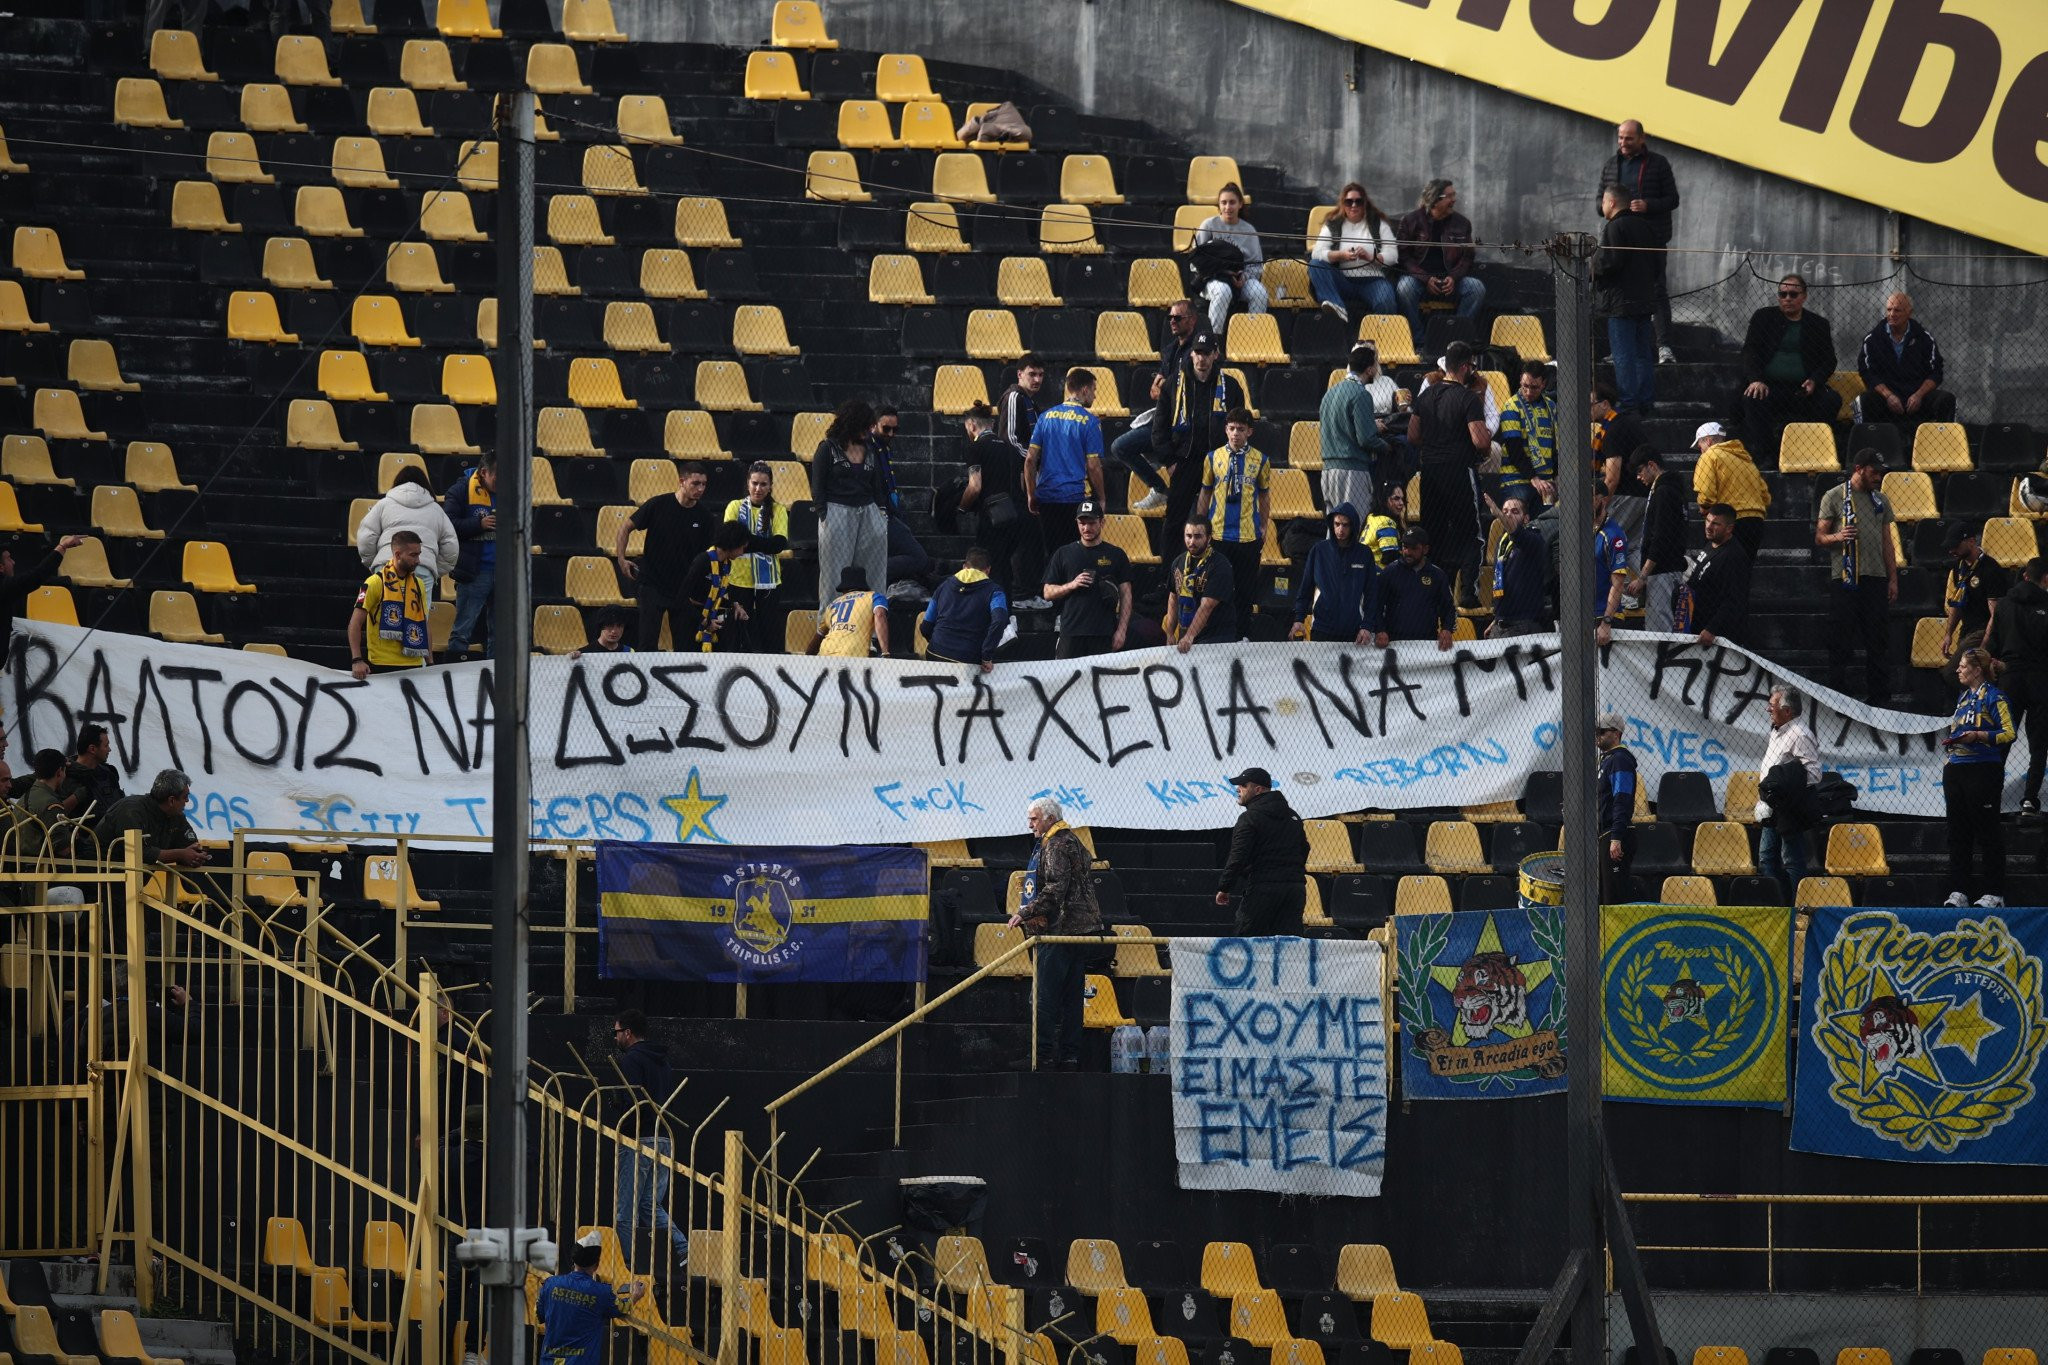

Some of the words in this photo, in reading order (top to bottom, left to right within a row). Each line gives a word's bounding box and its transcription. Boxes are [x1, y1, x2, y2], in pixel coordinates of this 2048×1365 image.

[1045, 409, 1089, 425] novibet
[1021, 657, 1277, 768] ΧΕΡΙΑ
[1291, 647, 1427, 750] ΝΑ
[1621, 715, 1729, 779] IVES
[445, 792, 653, 843] TGERS
[722, 863, 801, 887] ASTERAS
[710, 905, 726, 917] 19
[801, 905, 816, 918] 31
[726, 937, 781, 965] TRIPOLIS
[1654, 941, 1711, 964] Tigers
[1845, 913, 2007, 983] Tigers
[1183, 992, 1385, 1051] ΕΧΟΥΜΕ
[1437, 1054, 1453, 1071] Et
[1455, 1056, 1469, 1069] in
[1473, 1045, 1528, 1067] Arcadia
[1532, 1040, 1554, 1058] ego
[1181, 1055, 1387, 1102] ΕΙΜΑΣΤΕ
[1200, 1099, 1387, 1171] ΕΜΕΙΣ
[551, 1286, 597, 1305] ASTERAS
